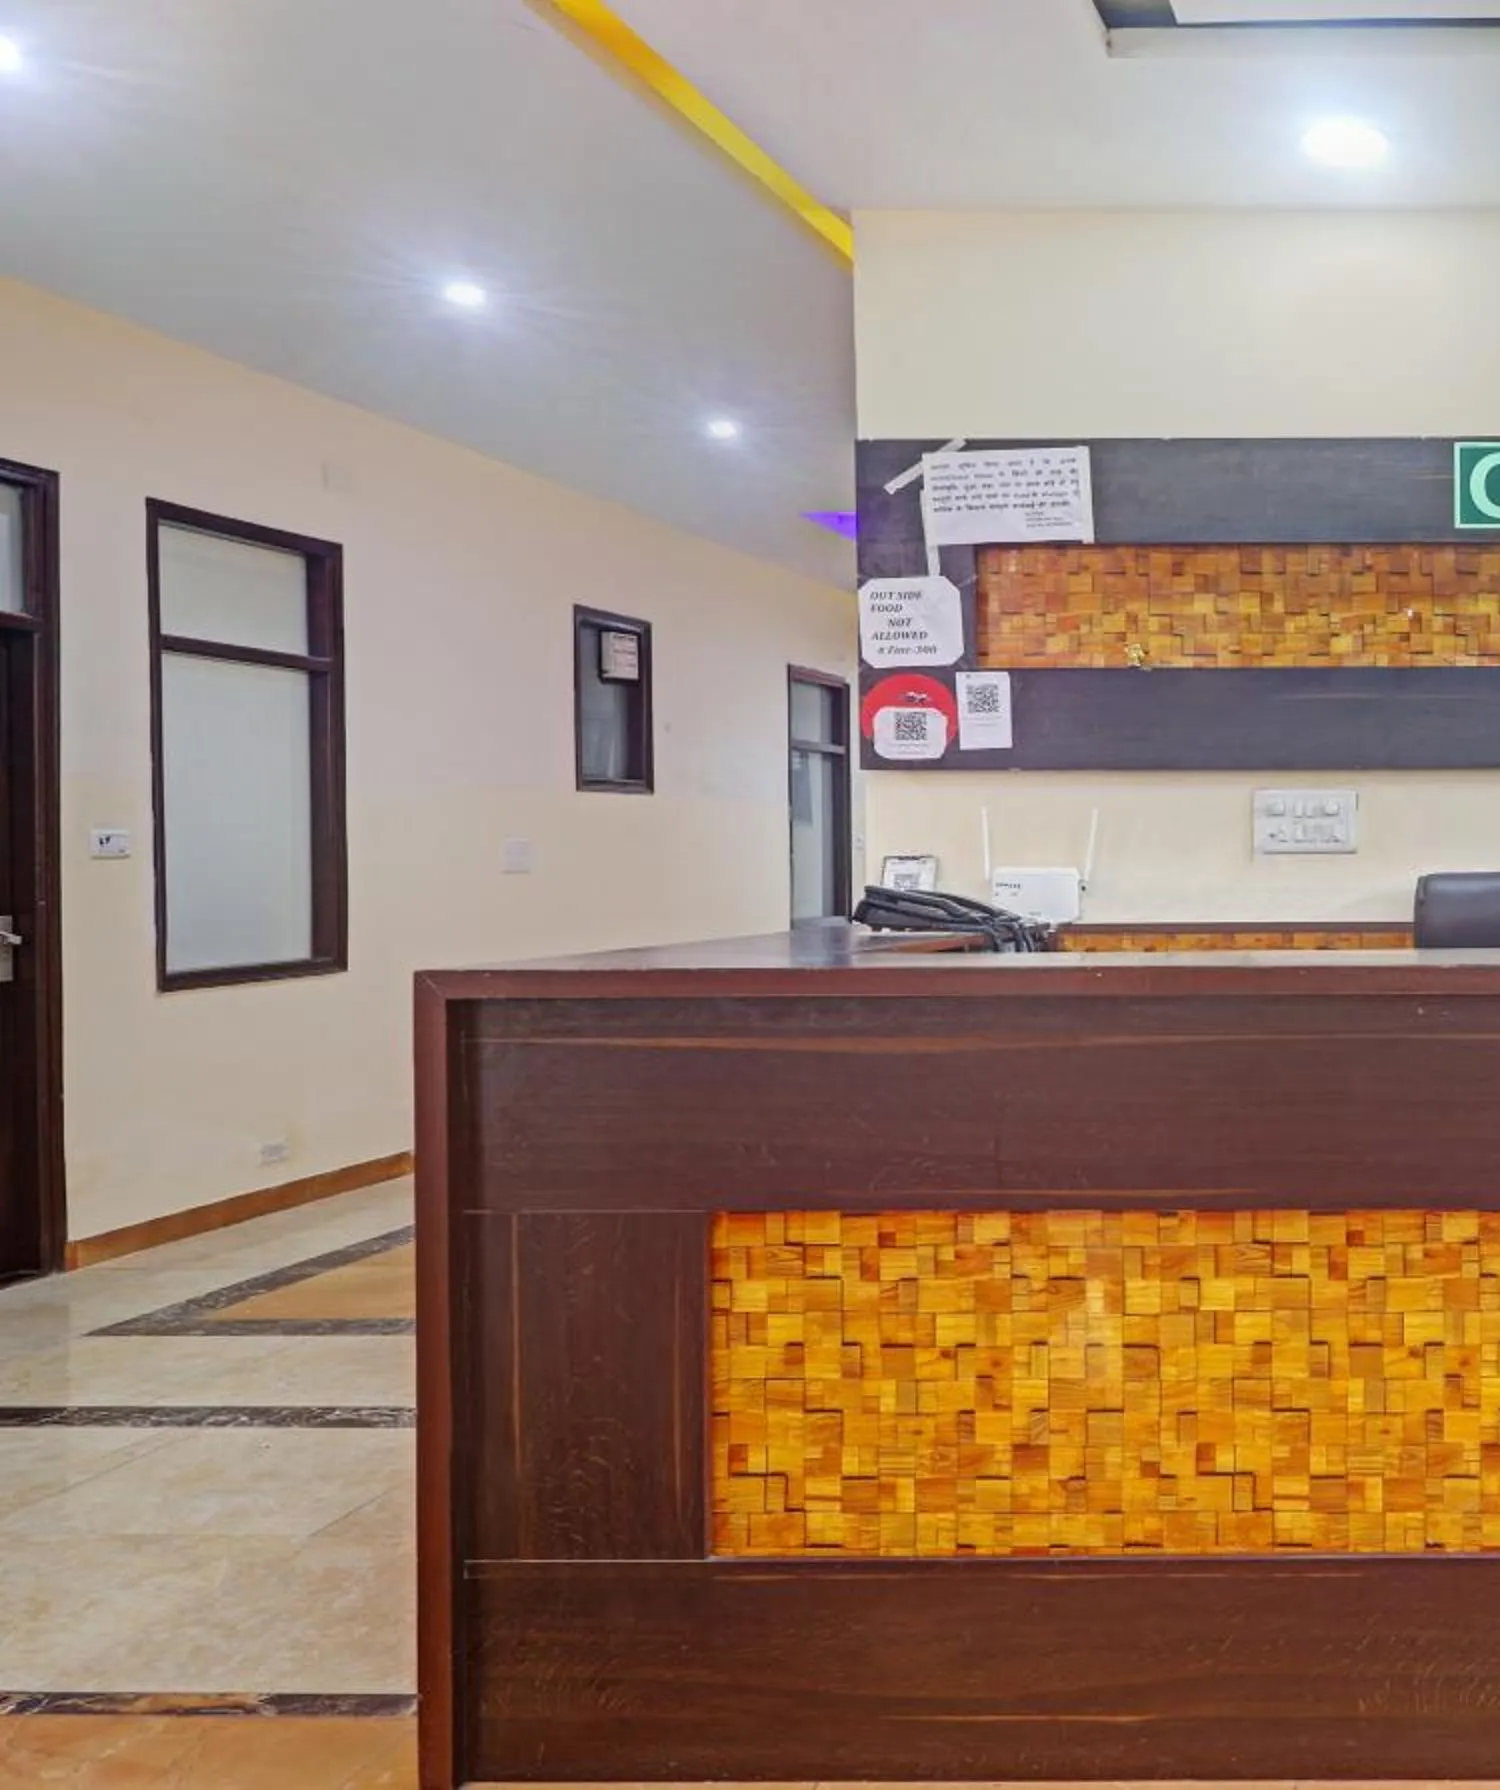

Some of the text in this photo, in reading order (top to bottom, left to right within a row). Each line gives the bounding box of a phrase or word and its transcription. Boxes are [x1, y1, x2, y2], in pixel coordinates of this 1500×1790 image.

[871, 604, 903, 613] FOOD
[888, 617, 912, 627] NOT
[871, 631, 928, 641] ALLOWED
